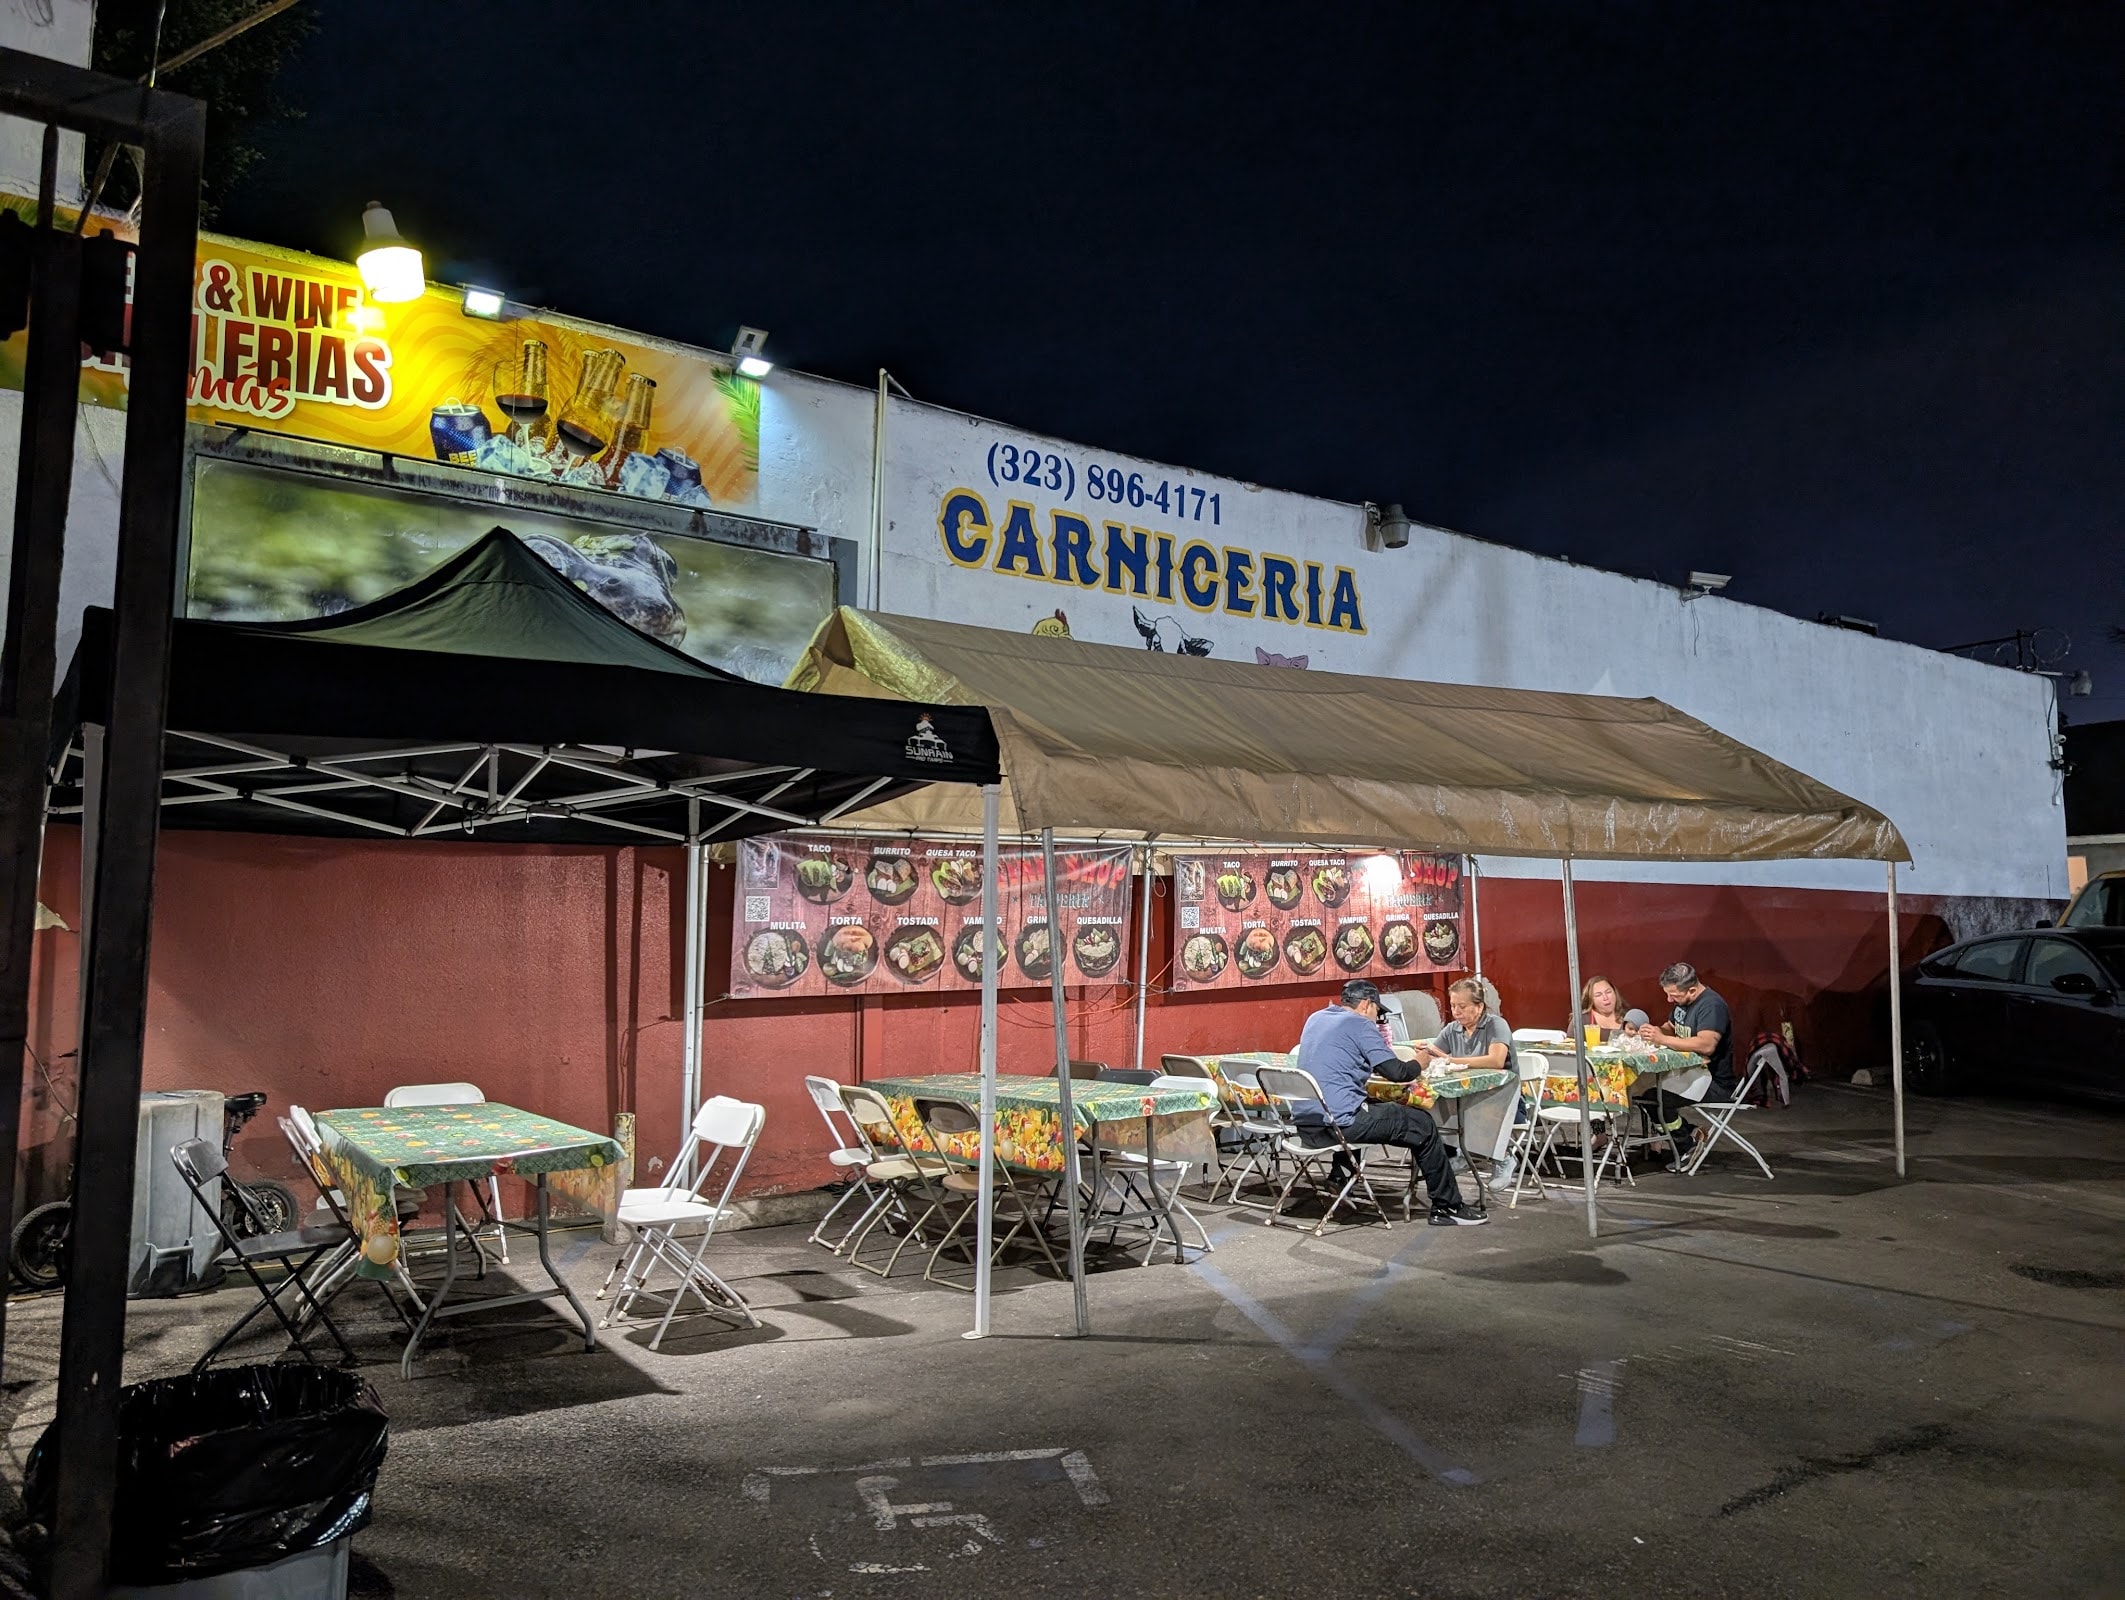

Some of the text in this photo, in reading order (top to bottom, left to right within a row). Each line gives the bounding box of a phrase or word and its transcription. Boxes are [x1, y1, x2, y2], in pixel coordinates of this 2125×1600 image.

[203, 262, 237, 314] &
[449, 451, 478, 465] BEE
[987, 441, 1221, 525] (323) 896-4171
[938, 487, 1368, 636] CARNICERIA
[807, 844, 832, 853] TACO
[873, 846, 911, 856] BURRITO
[926, 849, 977, 858] QUESA TACO
[1223, 861, 1241, 869] TACO
[830, 916, 863, 925] TORTA
[897, 916, 939, 926] TOSTADA
[963, 916, 1003, 925] VAMO
[1026, 915, 1048, 924] GRIN
[1077, 916, 1123, 925] QUESADILLA
[1338, 916, 1368, 924] VAMPIRO
[1385, 913, 1410, 921] GRINGA
[1423, 912, 1459, 921] QUESADILLA
[770, 921, 807, 930] MULITA
[1243, 920, 1266, 929] TORTA
[1290, 918, 1321, 927] TOSTADA
[1200, 927, 1227, 935] MULITA
